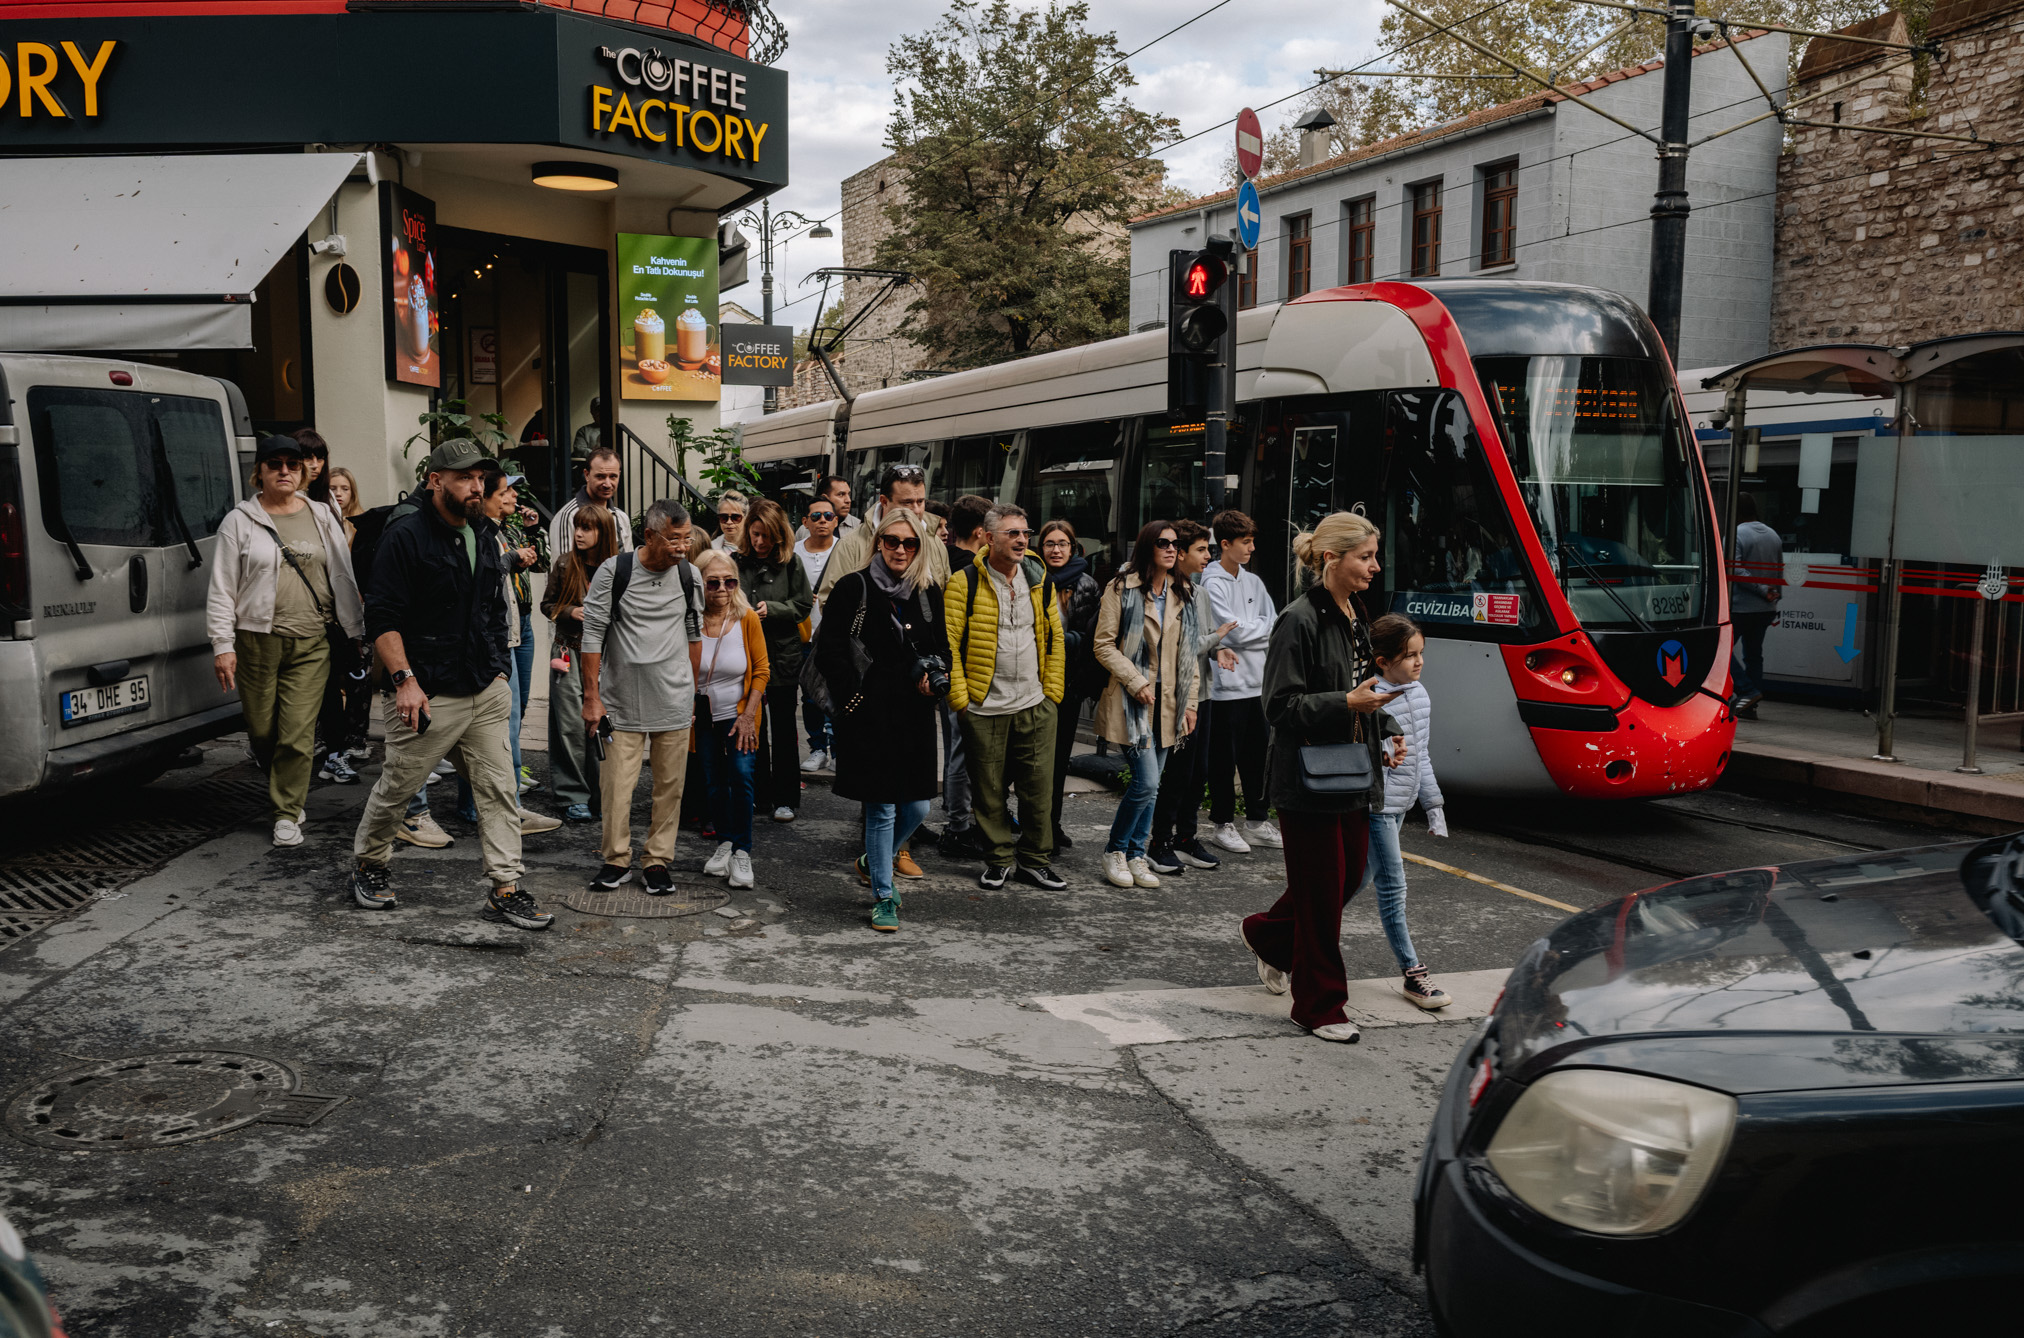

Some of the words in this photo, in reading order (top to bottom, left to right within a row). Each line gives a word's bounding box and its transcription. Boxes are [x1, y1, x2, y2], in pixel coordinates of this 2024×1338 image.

[0, 41, 117, 117] RY
[601, 46, 616, 58] The
[617, 47, 746, 111] COFFEE
[593, 85, 768, 162] FACTORY
[403, 209, 426, 243] Spice
[650, 256, 687, 267] Kahvenin
[633, 265, 644, 274] En
[662, 267, 704, 279] Dokunuşu!
[736, 342, 780, 355] COFFEE
[728, 354, 788, 369] FACTORY
[44, 602, 96, 618] RENAULT
[1406, 600, 1475, 617] CEVİZLİBA
[1652, 597, 1685, 614] 828B
[1782, 611, 1814, 619] METRO
[1782, 619, 1826, 631] İSTANBUL
[71, 693, 87, 715] 34
[97, 686, 121, 710] DHE
[130, 681, 145, 702] 95
